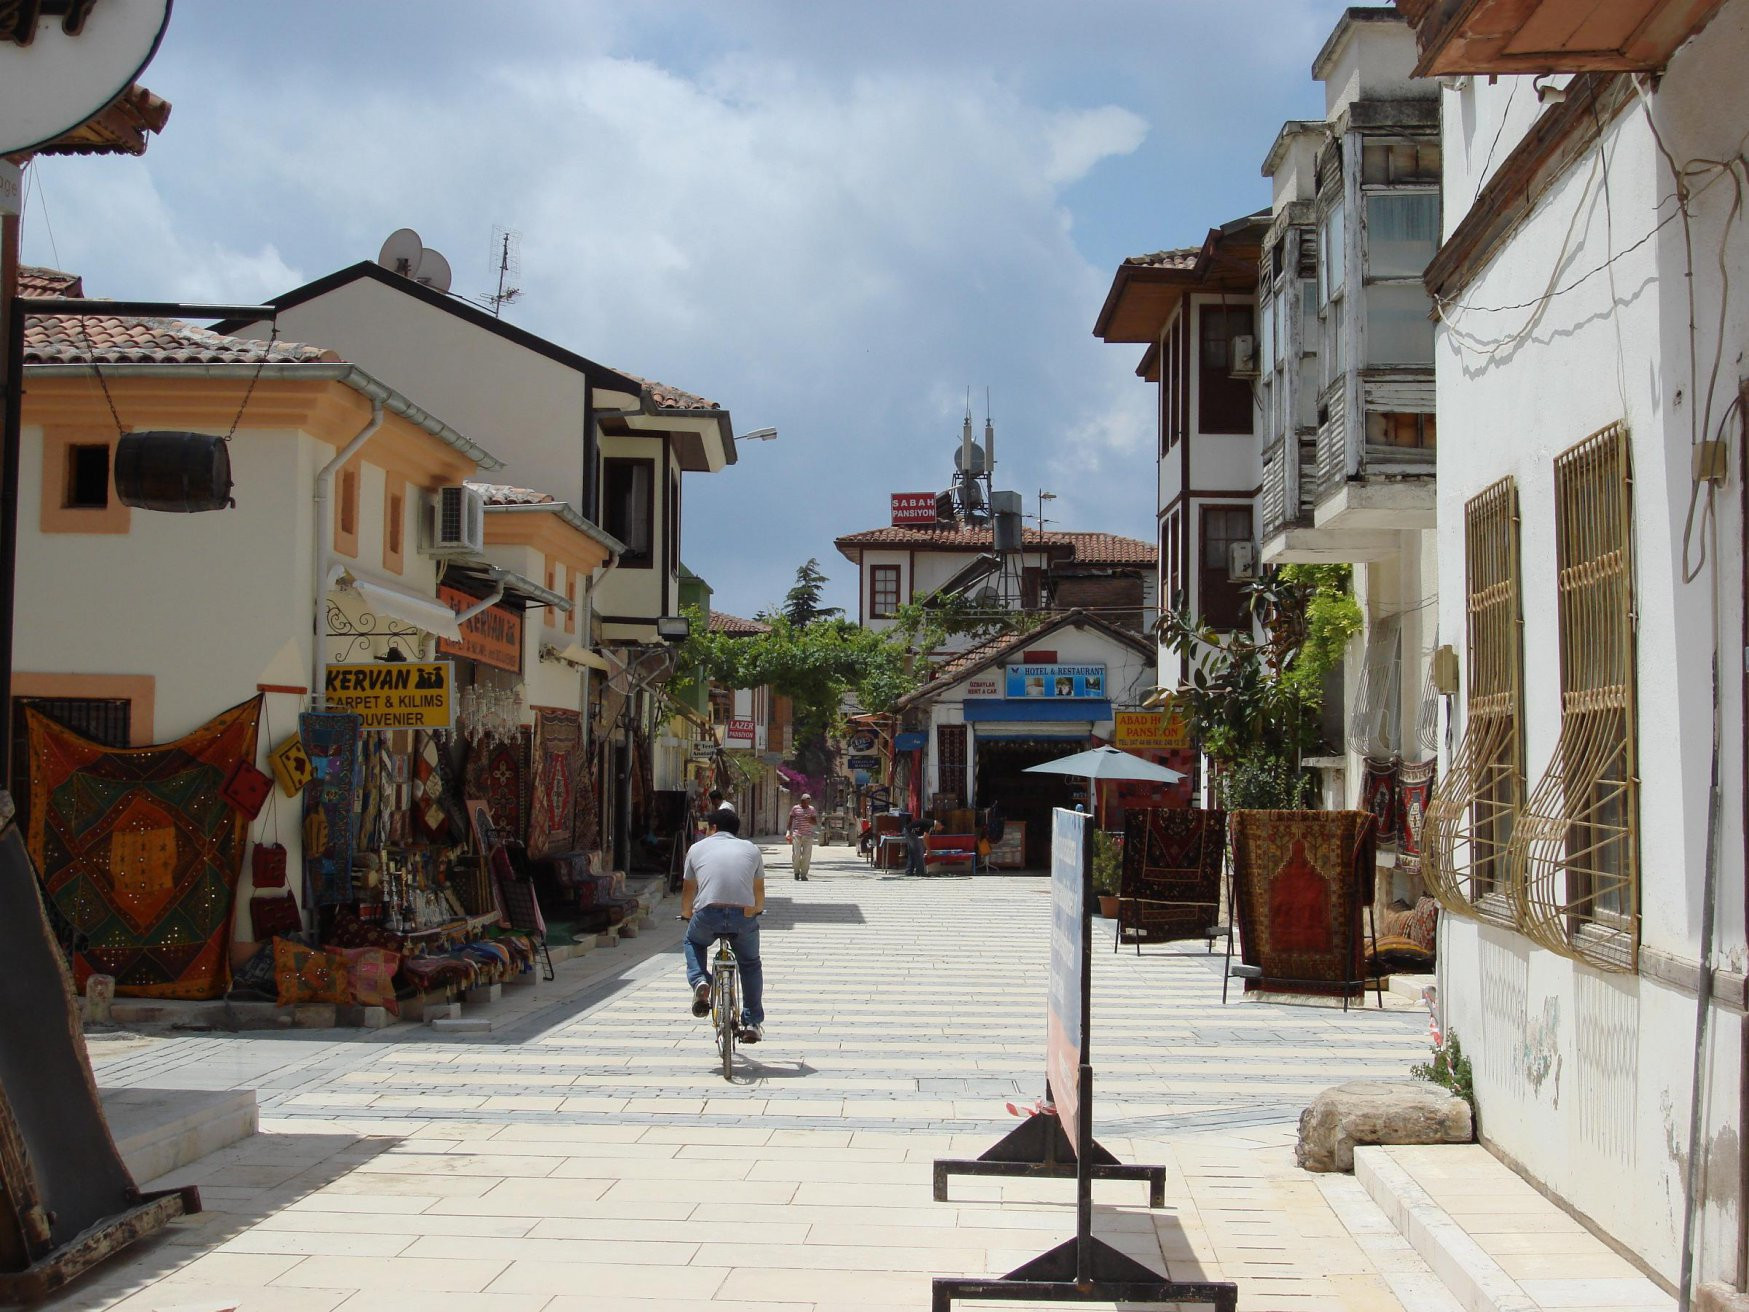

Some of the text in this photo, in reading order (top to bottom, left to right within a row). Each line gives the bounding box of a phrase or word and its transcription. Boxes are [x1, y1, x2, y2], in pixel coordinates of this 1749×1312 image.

[893, 499, 934, 507] SABAH
[1024, 667, 1048, 675] HOTEL
[1058, 667, 1105, 676] RESTAURANT
[326, 669, 411, 692] KERVAN
[326, 694, 444, 710] CARPET & KILIMS
[358, 712, 425, 726] OUVENIER
[1119, 716, 1147, 725] ABAD
[730, 721, 754, 730] LAZER
